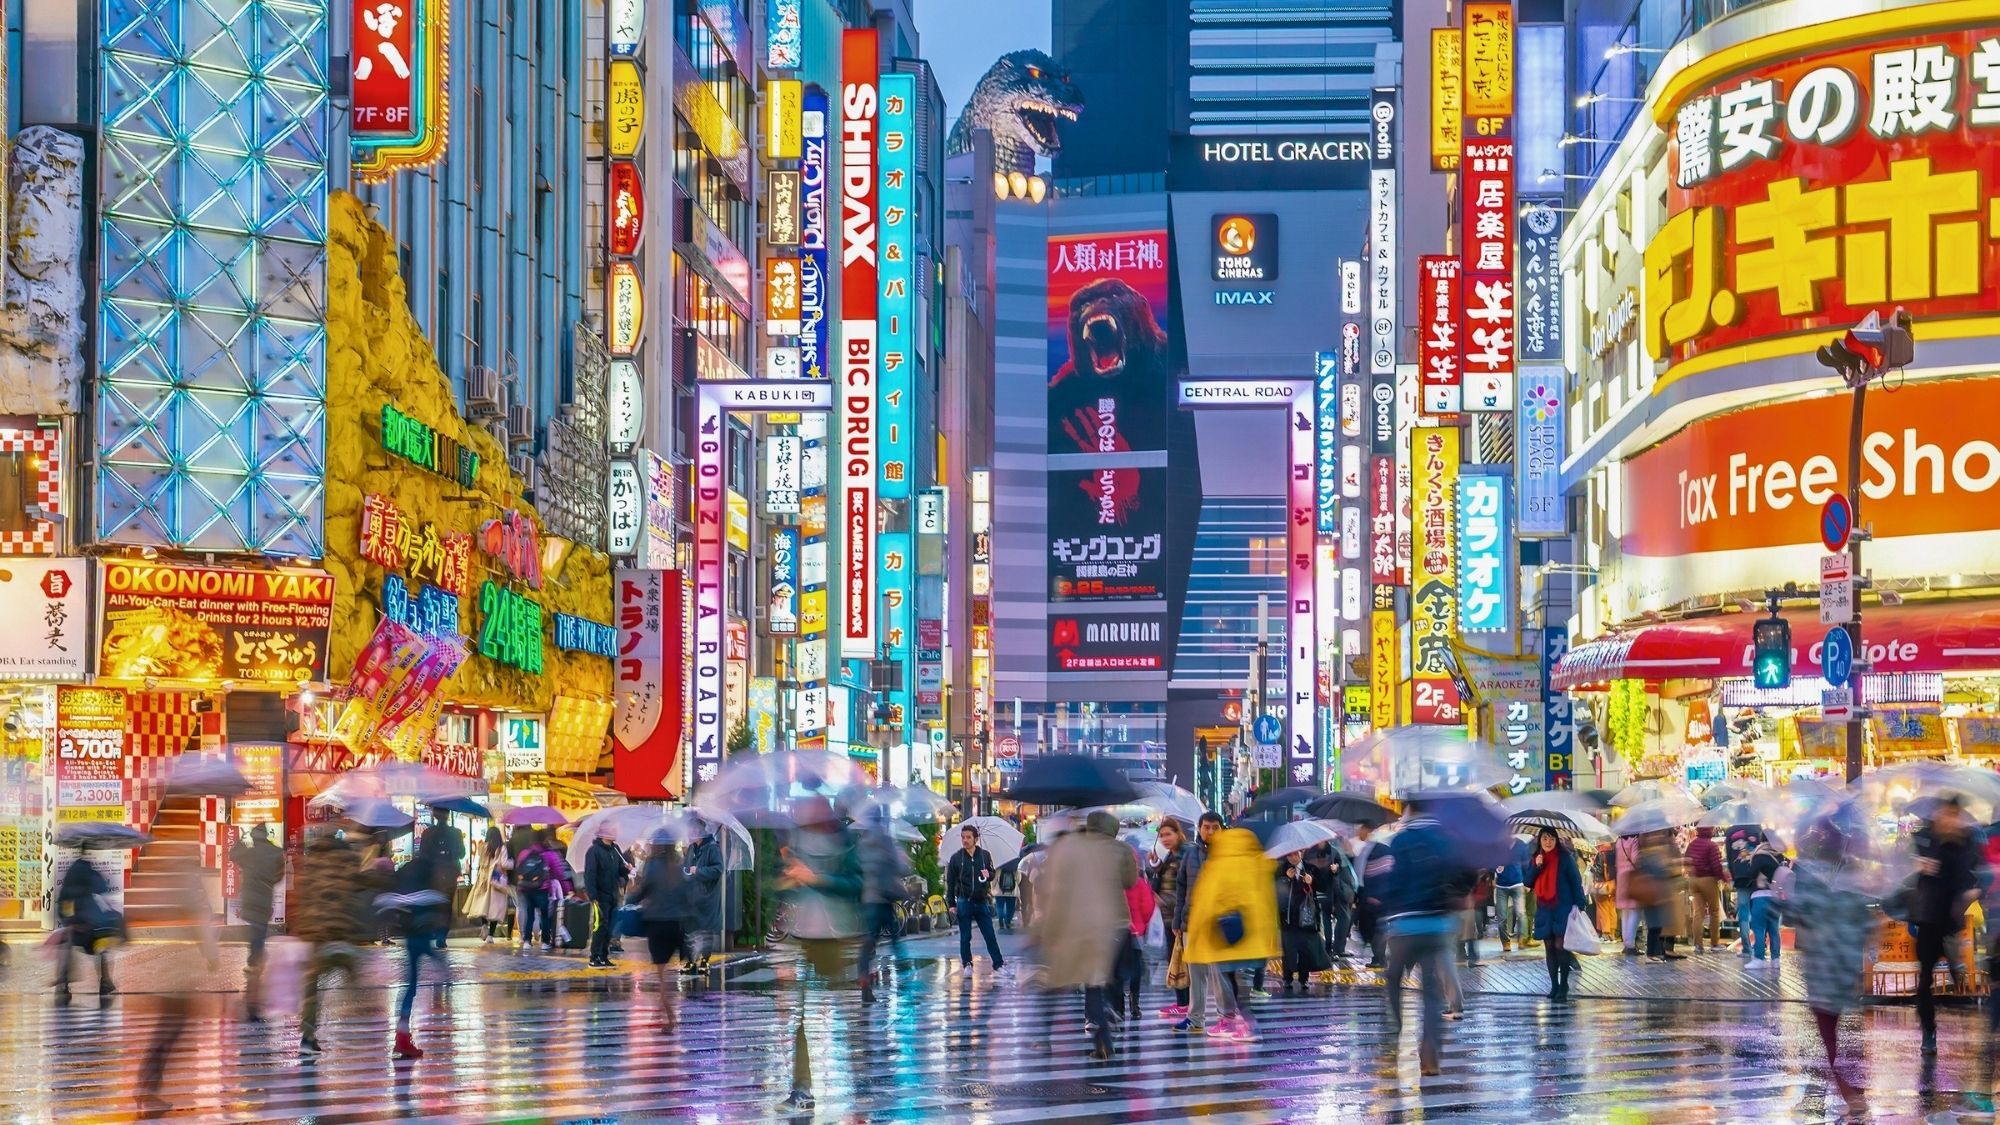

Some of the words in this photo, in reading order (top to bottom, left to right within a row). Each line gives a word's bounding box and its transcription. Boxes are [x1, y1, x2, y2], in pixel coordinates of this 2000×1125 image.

[1372, 101, 1395, 160] Booth
[1476, 117, 1505, 136] 6F
[1204, 143, 1275, 162] HOTEL
[1440, 156, 1460, 169] 6F
[844, 83, 877, 268] SHIDAX
[1378, 177, 1389, 242] ネットカフェ
[1476, 179, 1505, 270] 居楽屋
[1218, 256, 1251, 268] TOHO
[1218, 267, 1264, 279] CINEMAS
[801, 266, 824, 363] SHINJUKU
[1215, 291, 1273, 305] IMAX
[848, 339, 869, 386] BIC
[1184, 387, 1250, 398] CENTRAL
[1254, 387, 1293, 397] ROAD
[1372, 383, 1395, 441] Booth
[848, 396, 869, 477] DRUG
[1098, 397, 1116, 452] 勝つのは
[614, 443, 631, 453] 1F
[1529, 425, 1542, 480] STAGE
[1542, 426, 1555, 471] IDOL
[1424, 434, 1447, 549] きんくら酒場
[1529, 496, 1553, 513] 5F
[1678, 469, 1718, 529] Tax
[1729, 452, 1838, 516] Free
[614, 536, 631, 547] B1
[701, 441, 719, 619] GODZILLA
[1052, 533, 1161, 562] キングコング
[1372, 512, 1395, 576] 甘太郎
[774, 533, 792, 580] 海の家
[1466, 480, 1500, 624] カラオケ
[49, 573, 64, 595] 旨
[109, 566, 255, 597] OKONOMI
[264, 574, 333, 601] YAKI
[1294, 463, 1313, 705] ゴジラロード
[1374, 583, 1394, 596] 4F
[1374, 597, 1394, 610] 3F
[109, 595, 197, 609] All-You-Can-Eat
[199, 601, 235, 611] dinner
[237, 602, 260, 612] with
[261, 603, 329, 616] Free-Flowing
[197, 612, 233, 624] Drinks
[235, 614, 250, 624] for
[252, 615, 260, 625] 2
[262, 614, 293, 626] hours
[295, 616, 329, 628] ¥2,700
[620, 580, 644, 682] トラノコ
[1086, 622, 1161, 643] MARUHAN
[20, 657, 35, 666] Eat
[38, 657, 77, 667] standing
[239, 668, 293, 680] TORADYU
[1828, 641, 1839, 679] P
[699, 641, 718, 725] ROAD
[1507, 701, 1531, 795] カラオケ
